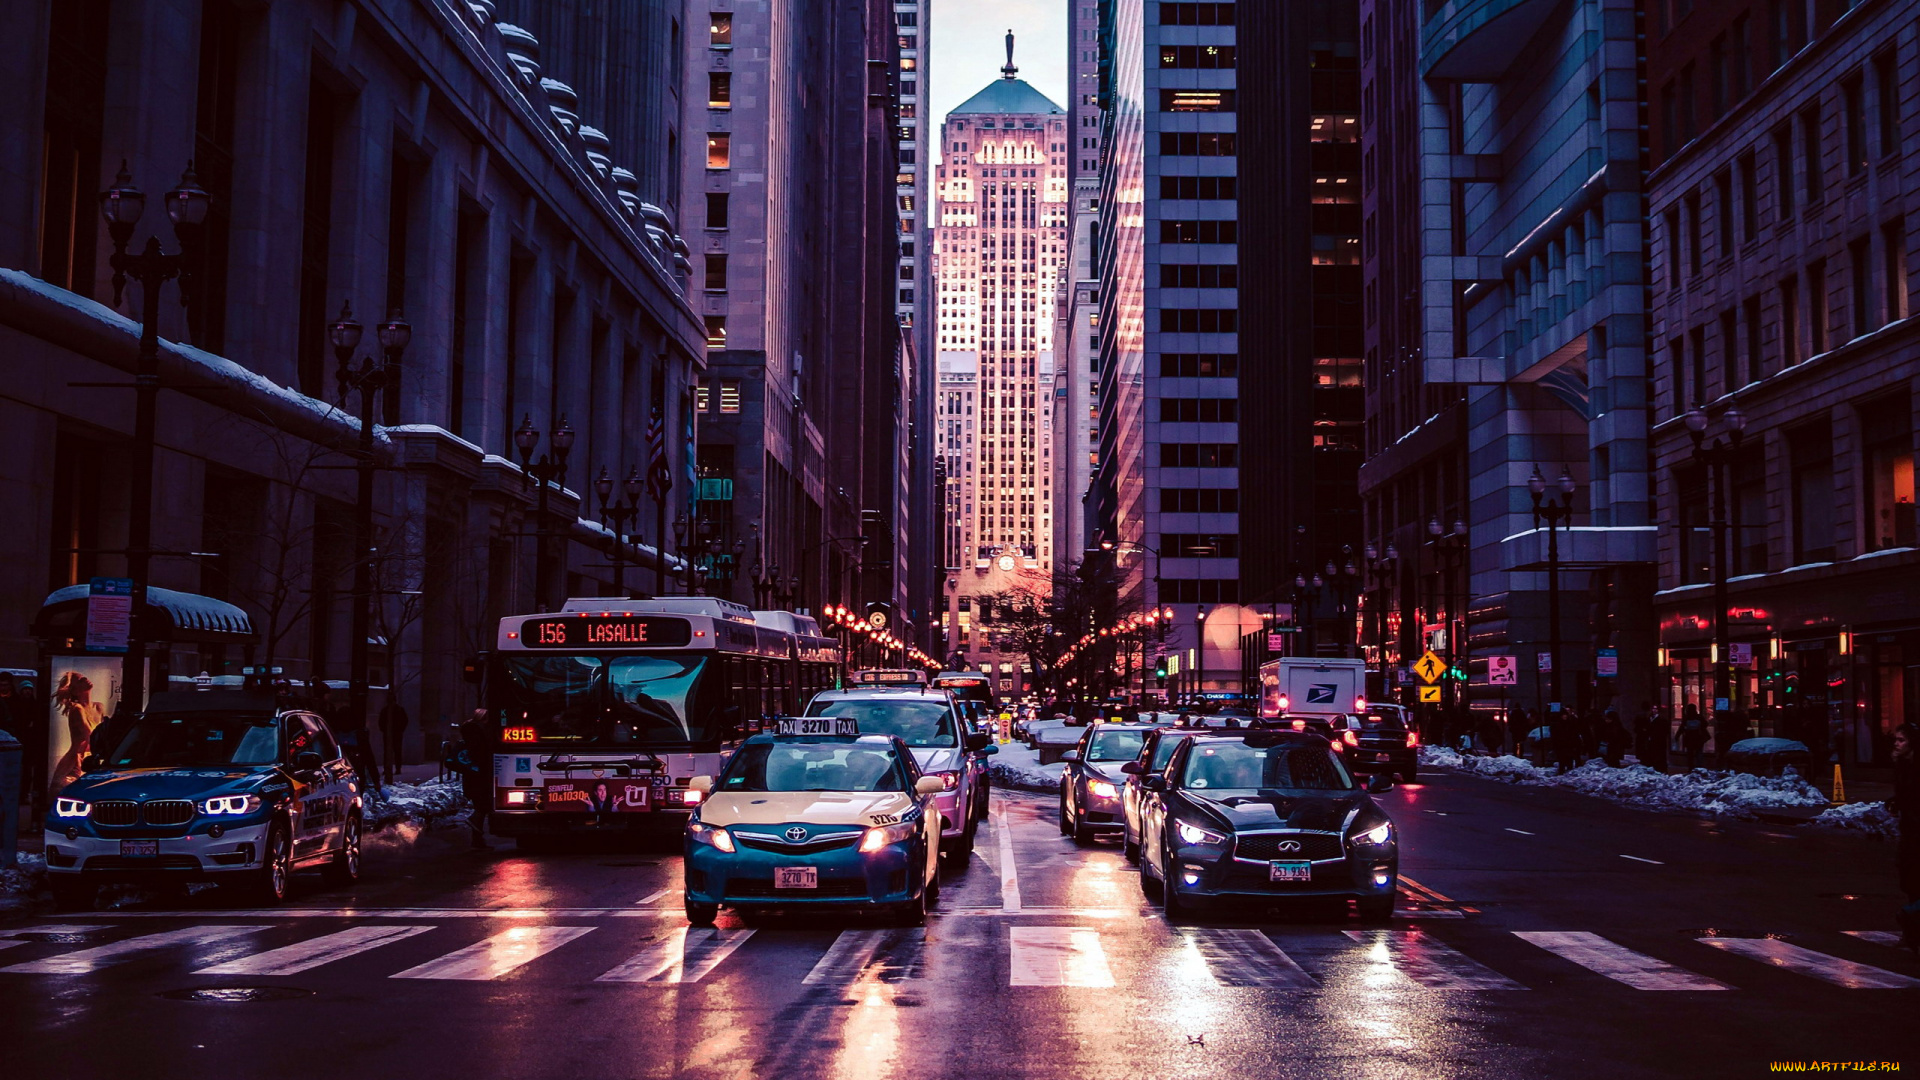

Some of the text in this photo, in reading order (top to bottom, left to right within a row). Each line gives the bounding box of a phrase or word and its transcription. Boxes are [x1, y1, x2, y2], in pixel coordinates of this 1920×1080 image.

[539, 623, 648, 643] 156 LASALLE
[778, 719, 856, 734] TAXI 3270 TAXI
[504, 729, 534, 741] K915
[548, 784, 574, 793] SEINFELD
[781, 872, 815, 883] 3270 TX
